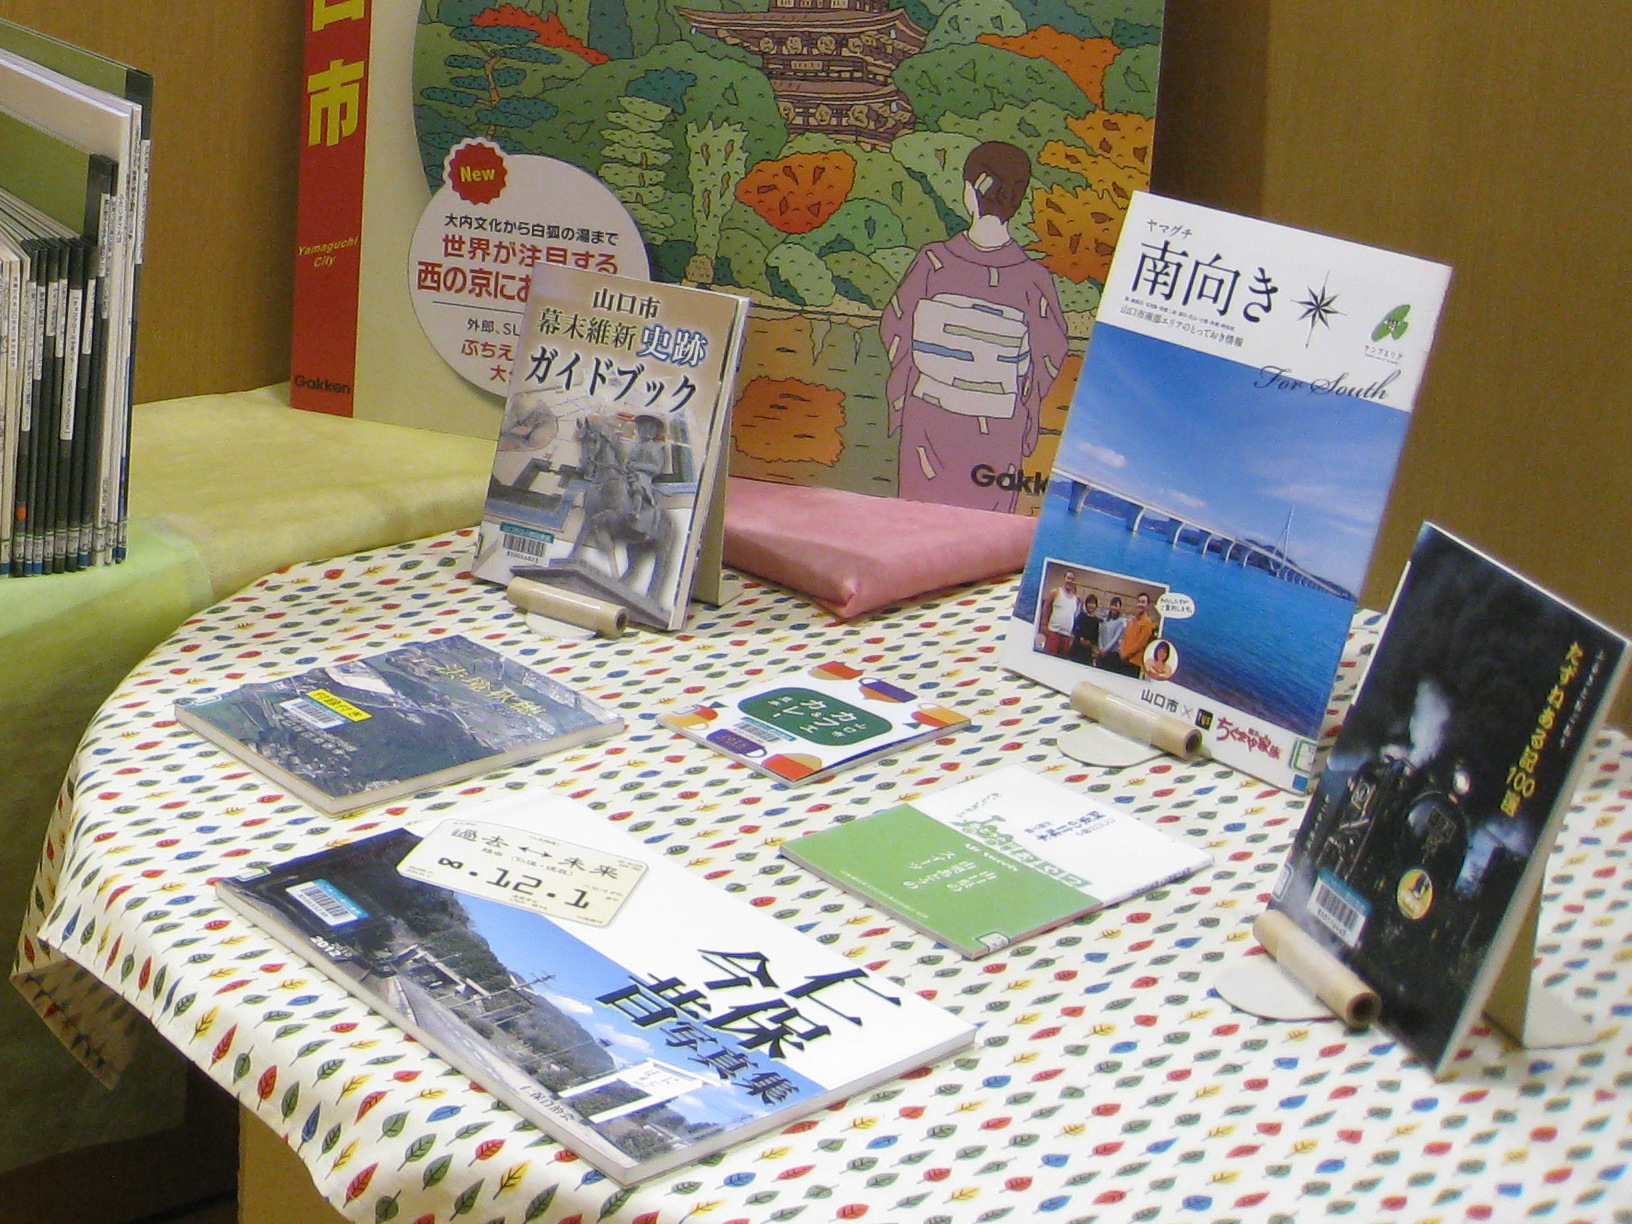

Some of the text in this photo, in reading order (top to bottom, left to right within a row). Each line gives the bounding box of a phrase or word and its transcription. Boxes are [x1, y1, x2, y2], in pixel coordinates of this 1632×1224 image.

[460, 166, 495, 183] New
[298, 236, 359, 257] Yamaguchi
[445, 214, 619, 246] 大内文化から白狐の湯まで
[1146, 219, 1193, 240] ヤマグチ
[314, 254, 336, 268] City
[442, 234, 619, 275] 世界が注目する
[1132, 240, 1280, 324] 南向き
[593, 289, 660, 319] 山口市
[294, 375, 350, 394] Gakken
[525, 346, 697, 413] ガイドブック
[1253, 365, 1401, 401] For South
[1141, 688, 1179, 713] 山口市
[452, 828, 619, 879] 過去 未来
[595, 949, 779, 1028] 今昔
[703, 968, 901, 1059] 仁保
[660, 1021, 800, 1105] 写真集
